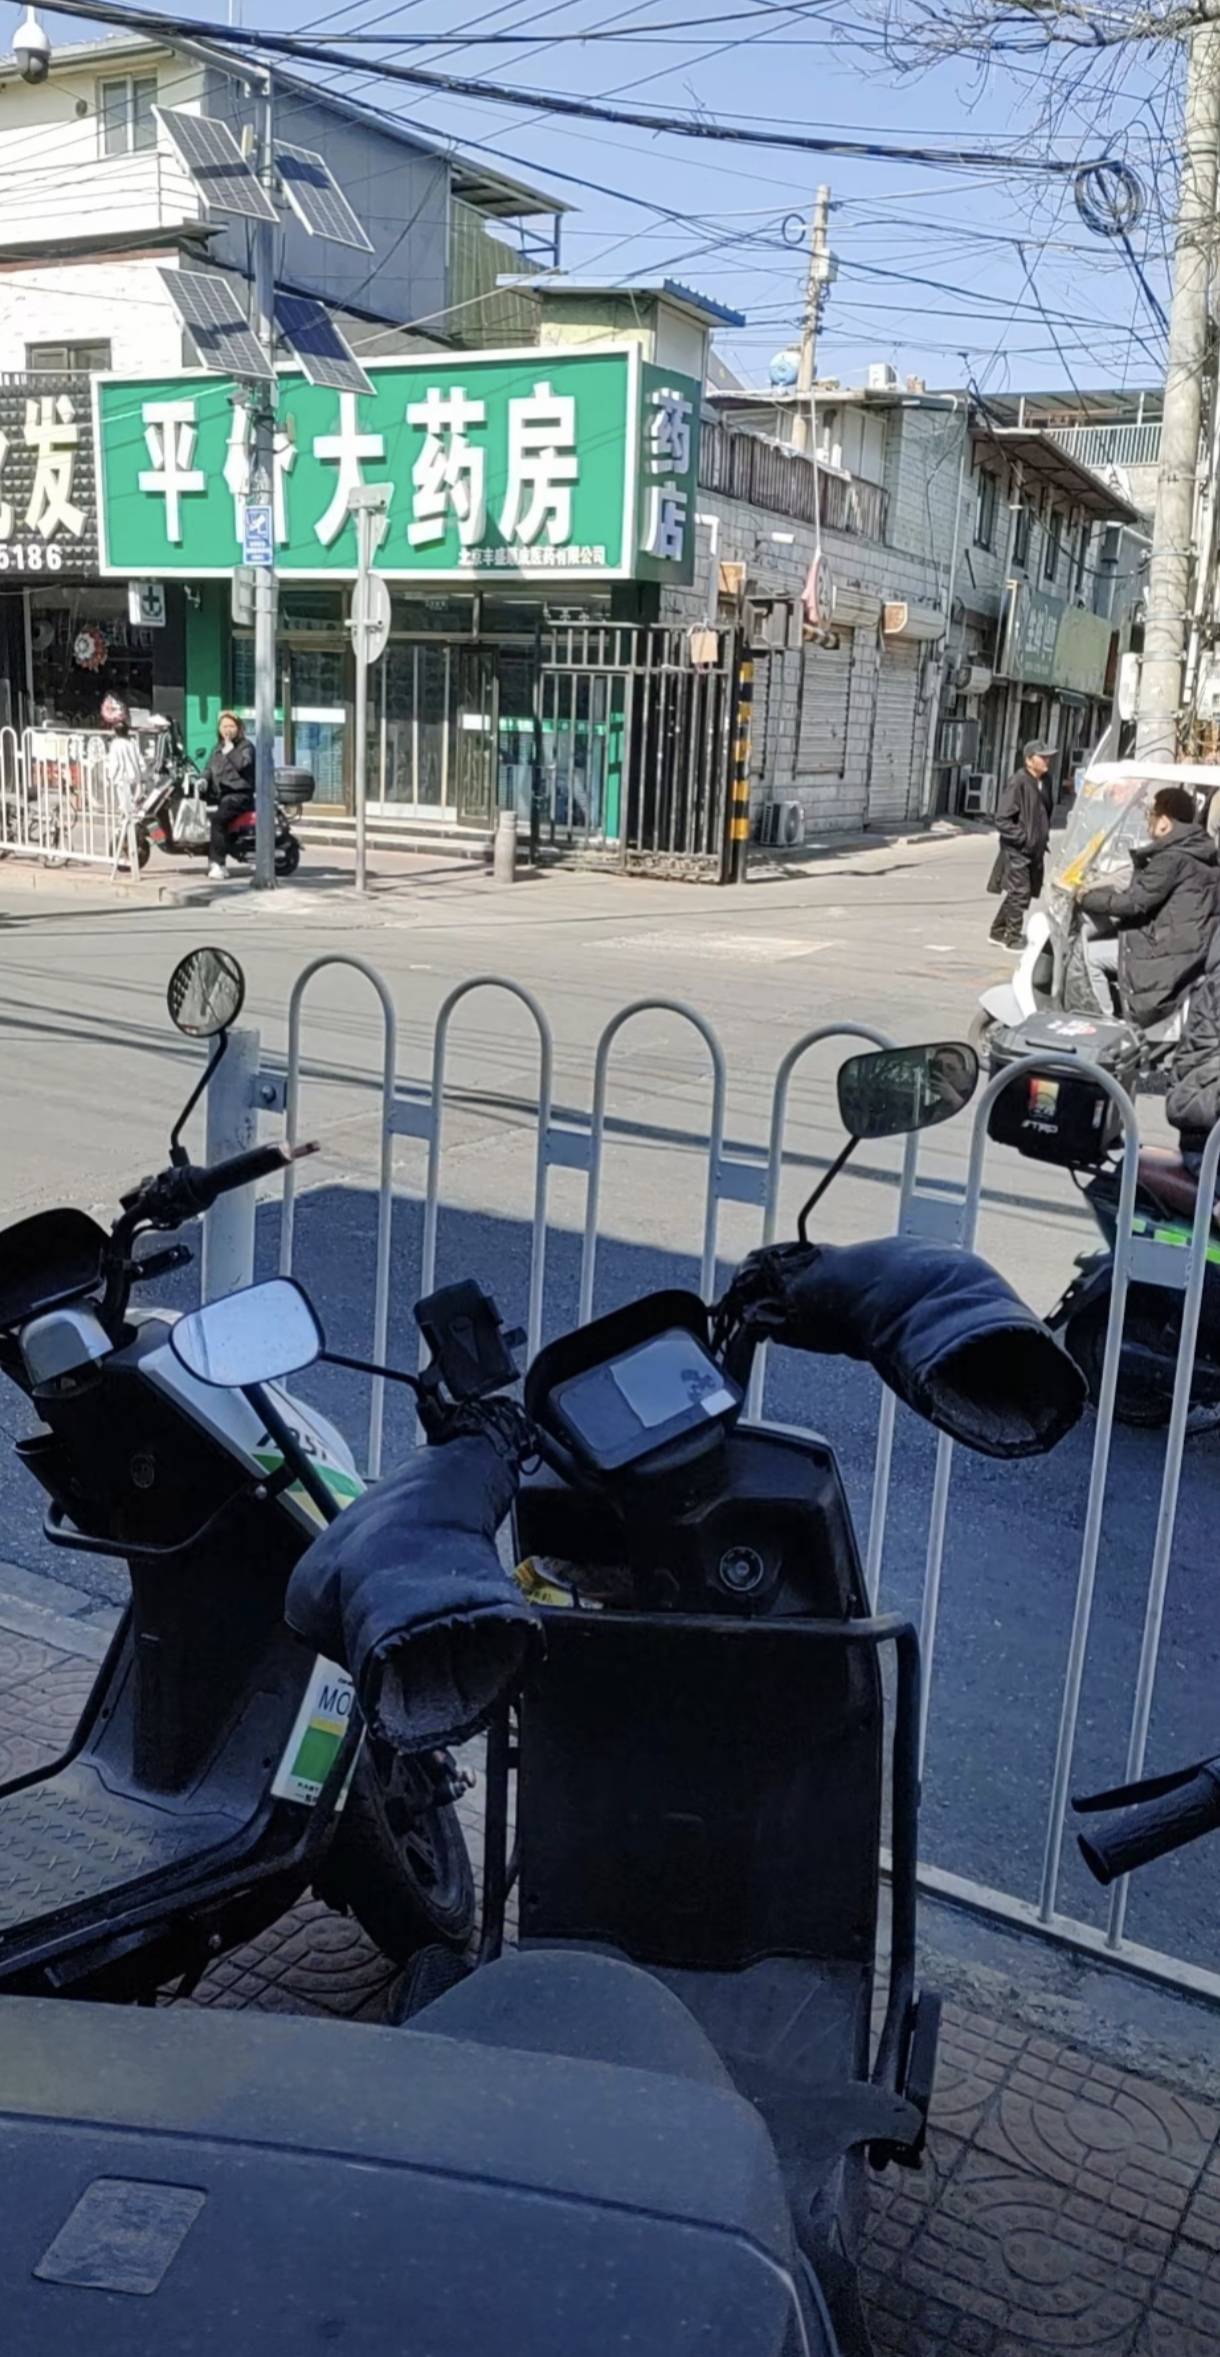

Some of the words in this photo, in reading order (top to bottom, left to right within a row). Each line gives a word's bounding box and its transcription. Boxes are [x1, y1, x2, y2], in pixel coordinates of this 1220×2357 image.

[0, 394, 88, 541] 发
[642, 387, 693, 561] 药店
[318, 1685, 353, 1717] MO
